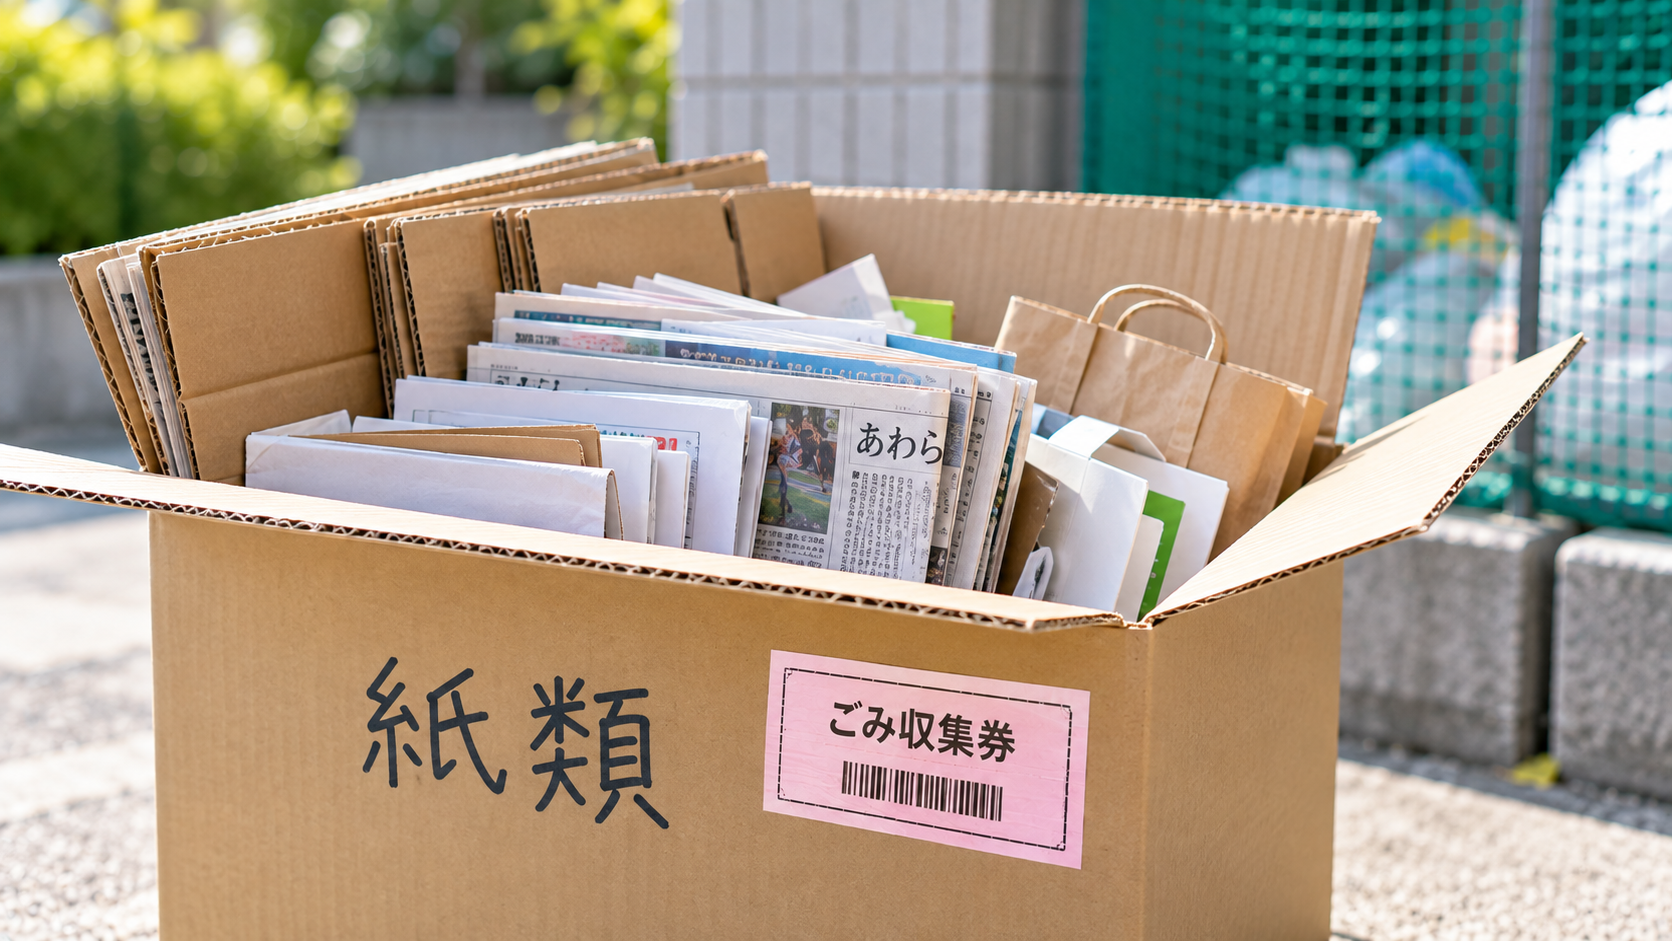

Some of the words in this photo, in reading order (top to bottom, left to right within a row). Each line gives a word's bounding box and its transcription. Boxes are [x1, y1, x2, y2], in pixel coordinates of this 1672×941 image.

[857, 422, 943, 465] あわら
[362, 656, 669, 829] 紙類
[829, 700, 1016, 762] ごみ収集券
